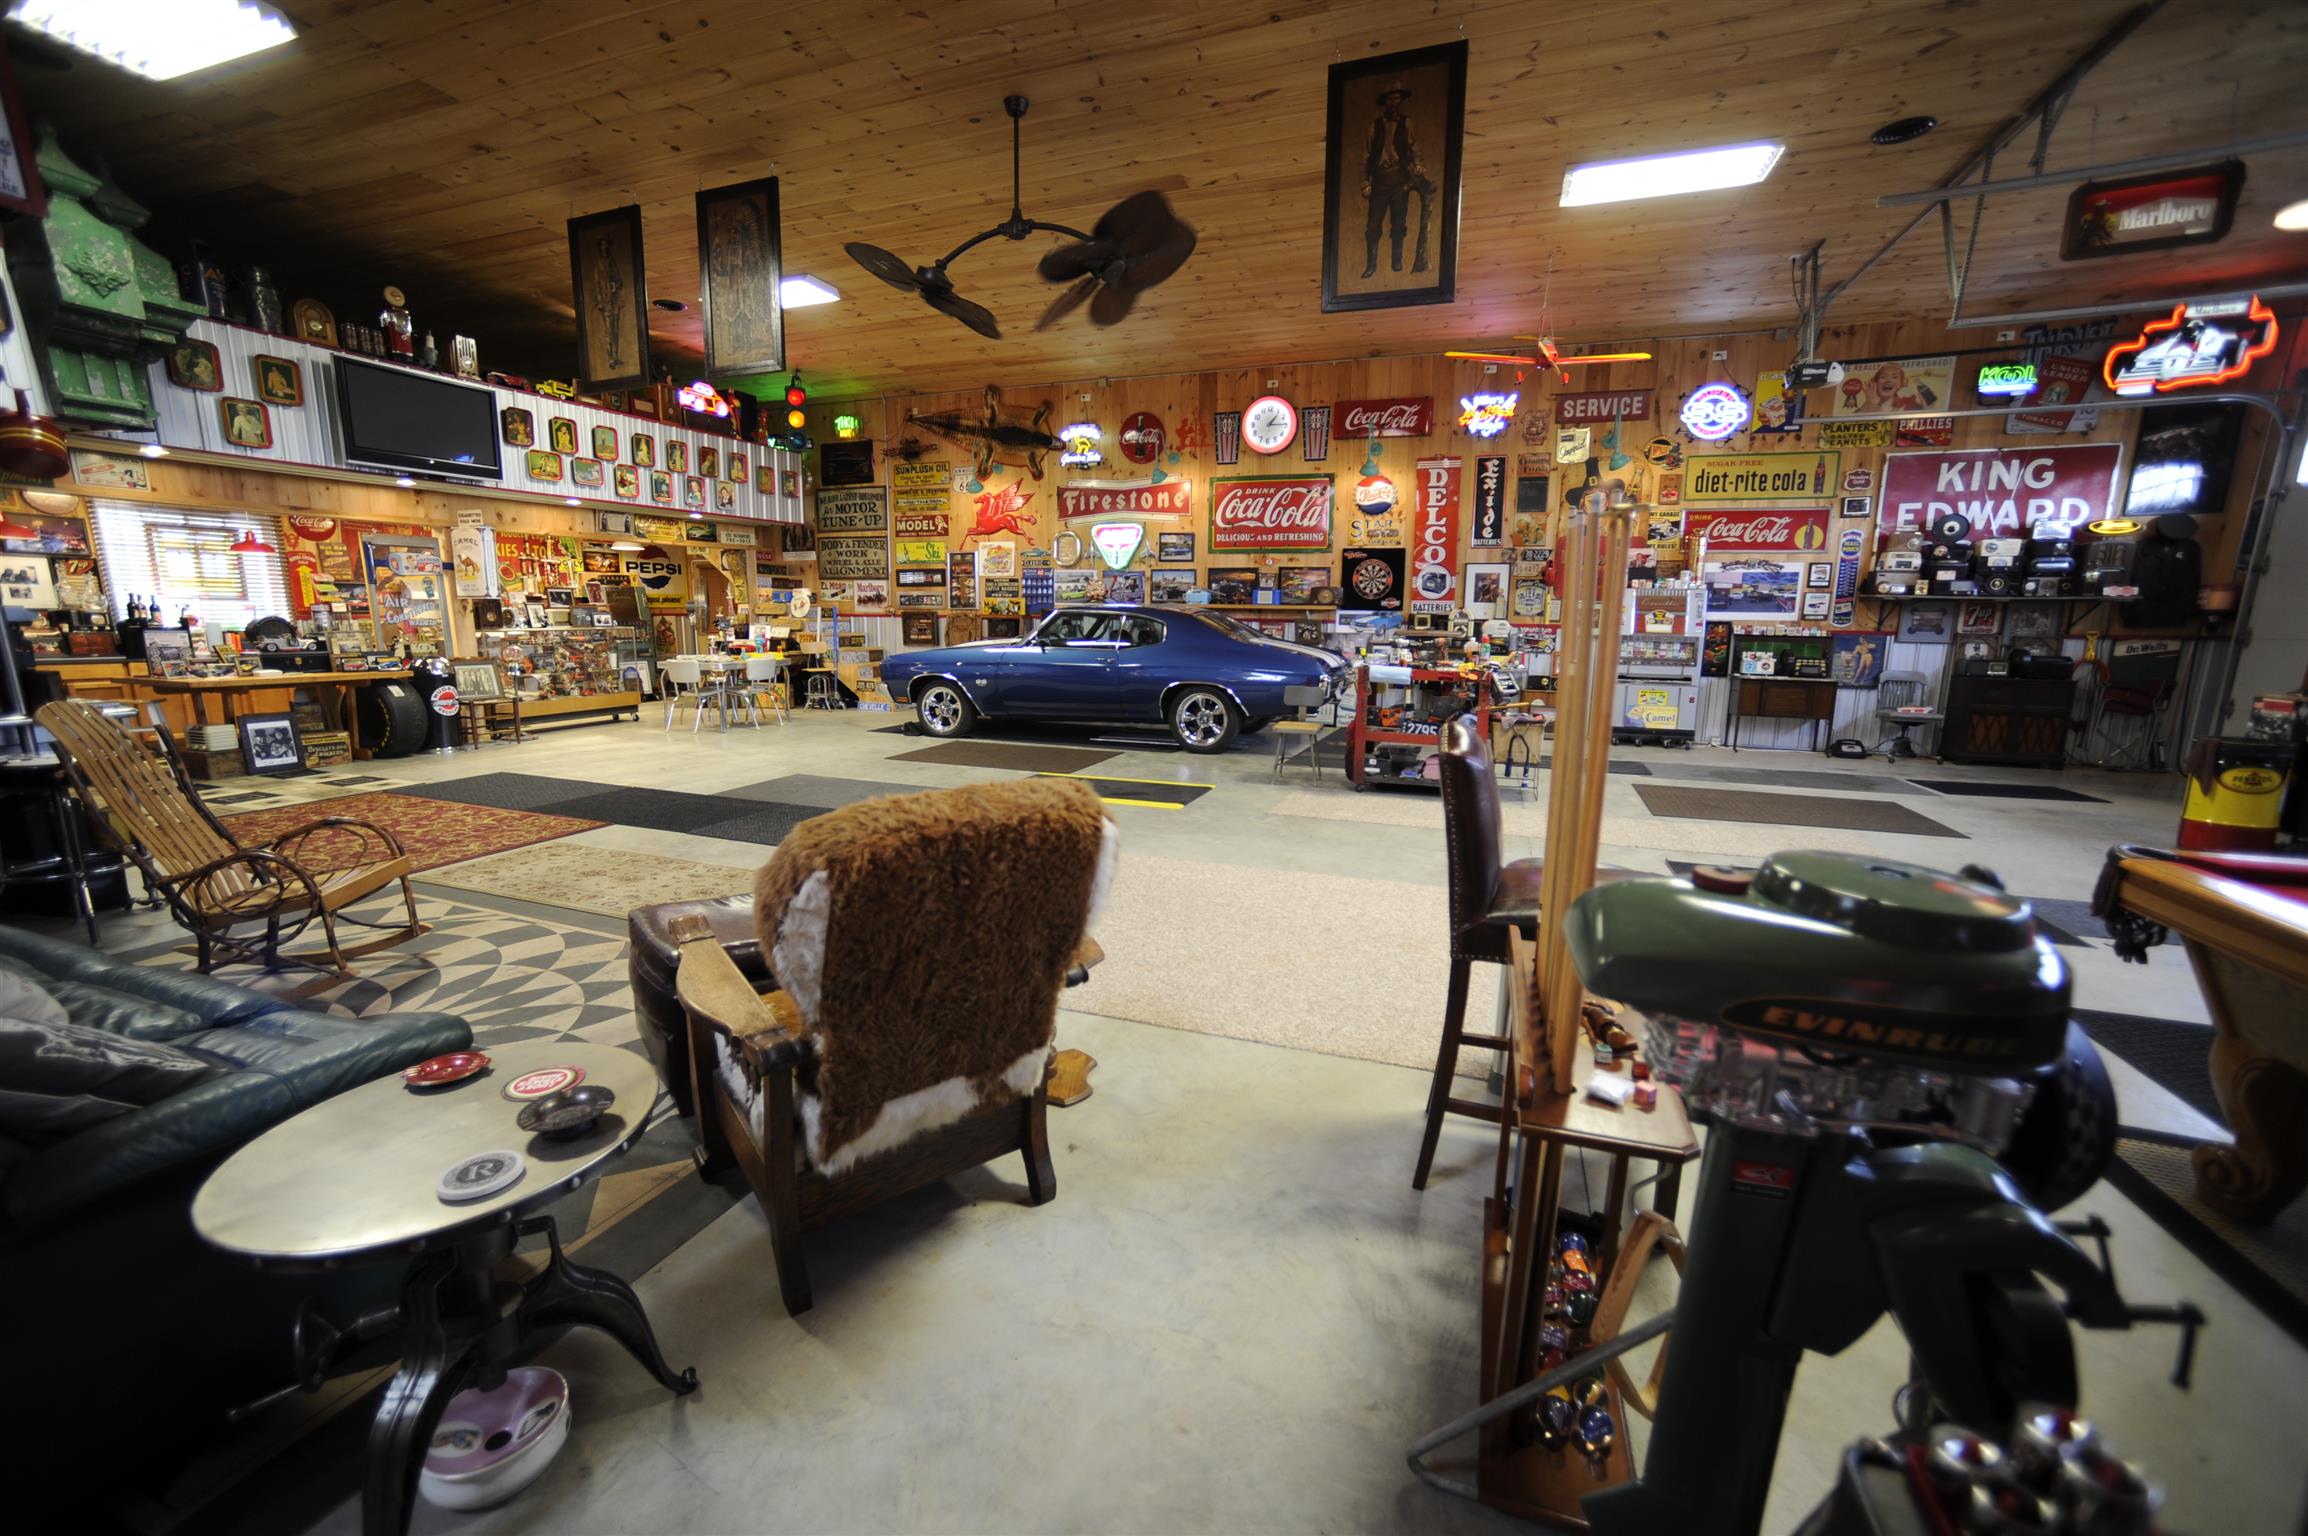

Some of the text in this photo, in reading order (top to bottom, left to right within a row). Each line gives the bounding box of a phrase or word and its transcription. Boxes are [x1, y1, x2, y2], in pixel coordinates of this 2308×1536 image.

[2118, 201, 2213, 231] Marlboro
[2051, 362, 2088, 375] UNION
[1979, 365, 2038, 386] KOOL
[2043, 369, 2088, 383] LEADER
[1563, 396, 1643, 418] SERVICE
[1345, 404, 1422, 431] Coca-Cola
[1899, 418, 1953, 430] PHILLIES
[2021, 413, 2065, 426] TOBACCO
[1823, 422, 1878, 433] PLANTERS
[936, 463, 949, 472] OIL
[1738, 459, 1764, 467] FREE
[1695, 469, 1806, 493] diet-rite cola
[1937, 457, 2056, 493] KING
[1245, 487, 1276, 495] DRINK
[1063, 490, 1185, 515] Firestone
[1480, 459, 1502, 539] Exide
[835, 501, 878, 514] MOTOR
[1216, 486, 1322, 528] Coca-Cola
[823, 514, 882, 527] TUNE-UP
[1423, 467, 1448, 565] DELCO
[897, 520, 935, 531] MODEL
[1351, 519, 1393, 538] STAR
[1705, 516, 1792, 544] Coca-Cola
[1216, 533, 1255, 542] DELICIOUS
[1274, 532, 1324, 541] REFRESHING
[1473, 538, 1501, 546] BATTERIES
[821, 540, 885, 550] BODY & FENDER
[925, 542, 941, 559] Ski
[836, 550, 868, 558] WORK
[625, 561, 682, 575] PEPSI
[823, 566, 886, 576] ALIGNMENT
[857, 583, 885, 592] Marlboro
[385, 594, 409, 607] AIR
[1412, 603, 1453, 612] BATTERIES
[1968, 605, 1993, 625] 7up
[1645, 712, 1675, 723] Camel
[1407, 722, 1437, 735] 2795
[1759, 1004, 2024, 1057] EVINRUDE
